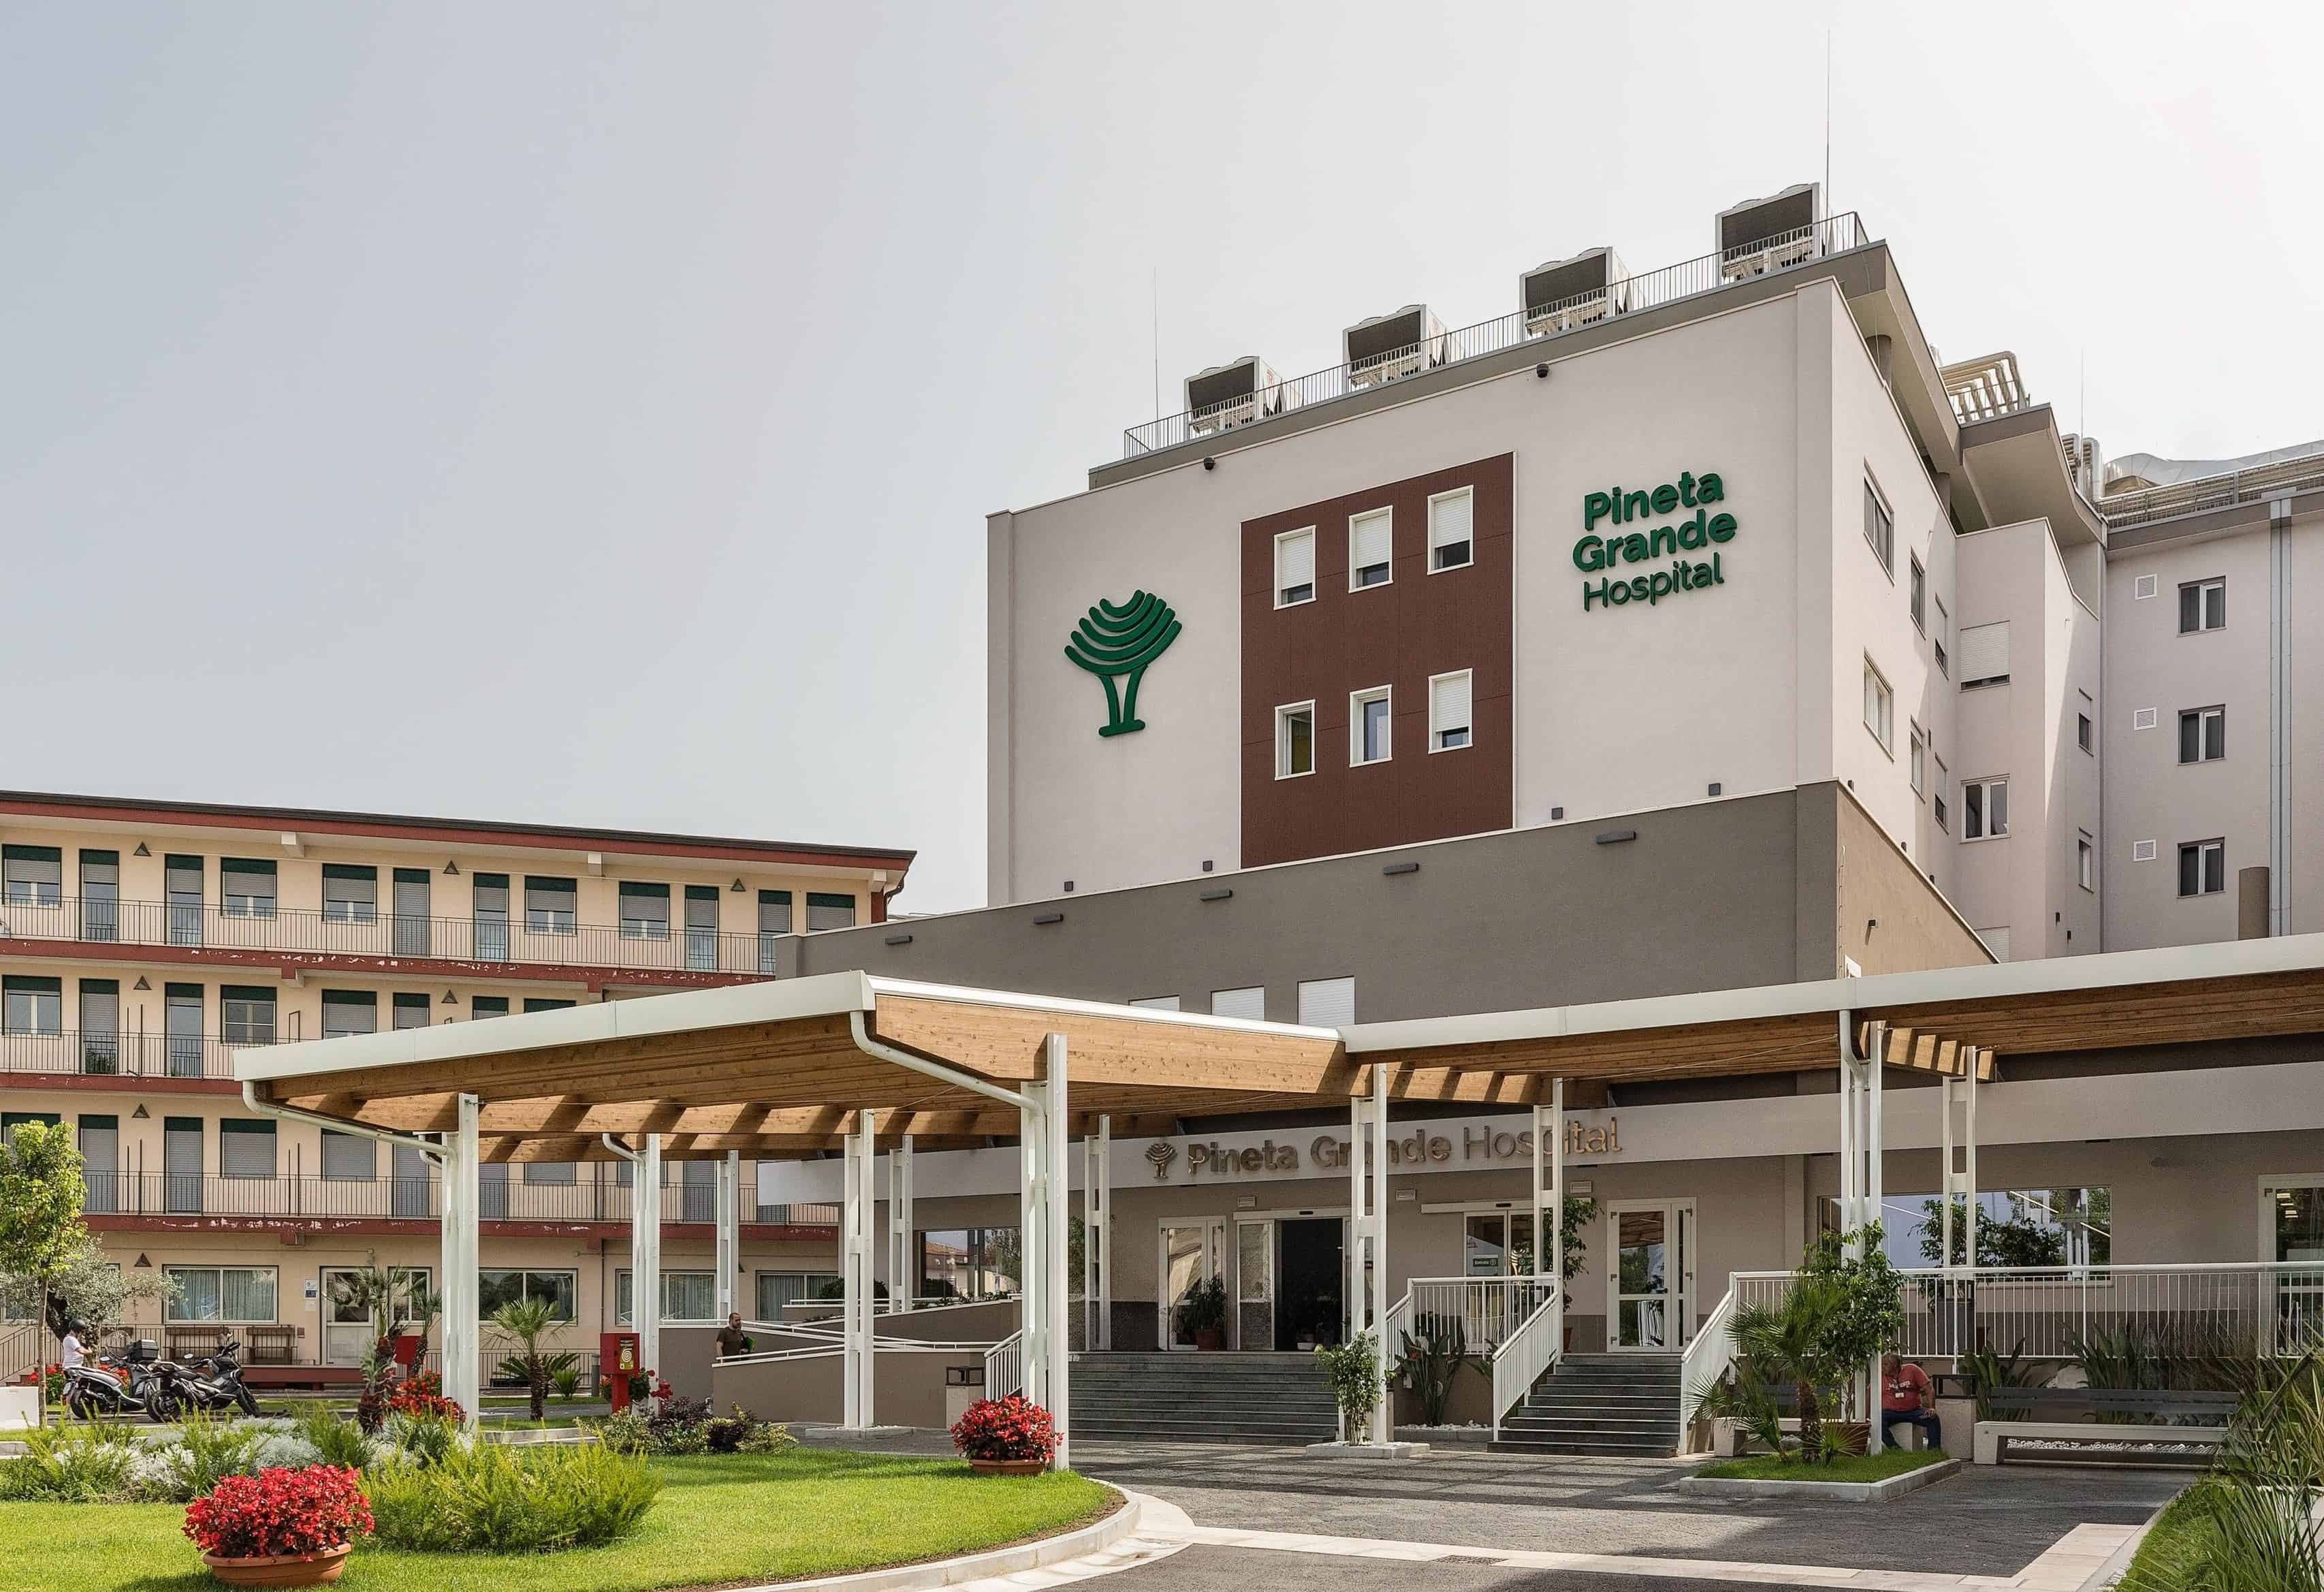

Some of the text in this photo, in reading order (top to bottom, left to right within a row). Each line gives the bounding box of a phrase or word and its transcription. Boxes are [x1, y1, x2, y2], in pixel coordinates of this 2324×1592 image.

[1584, 471, 1724, 531] Pineta
[1572, 508, 1738, 572] Grande
[1583, 552, 1724, 611] Hospital
[1188, 1140, 1299, 1175] Pineta
